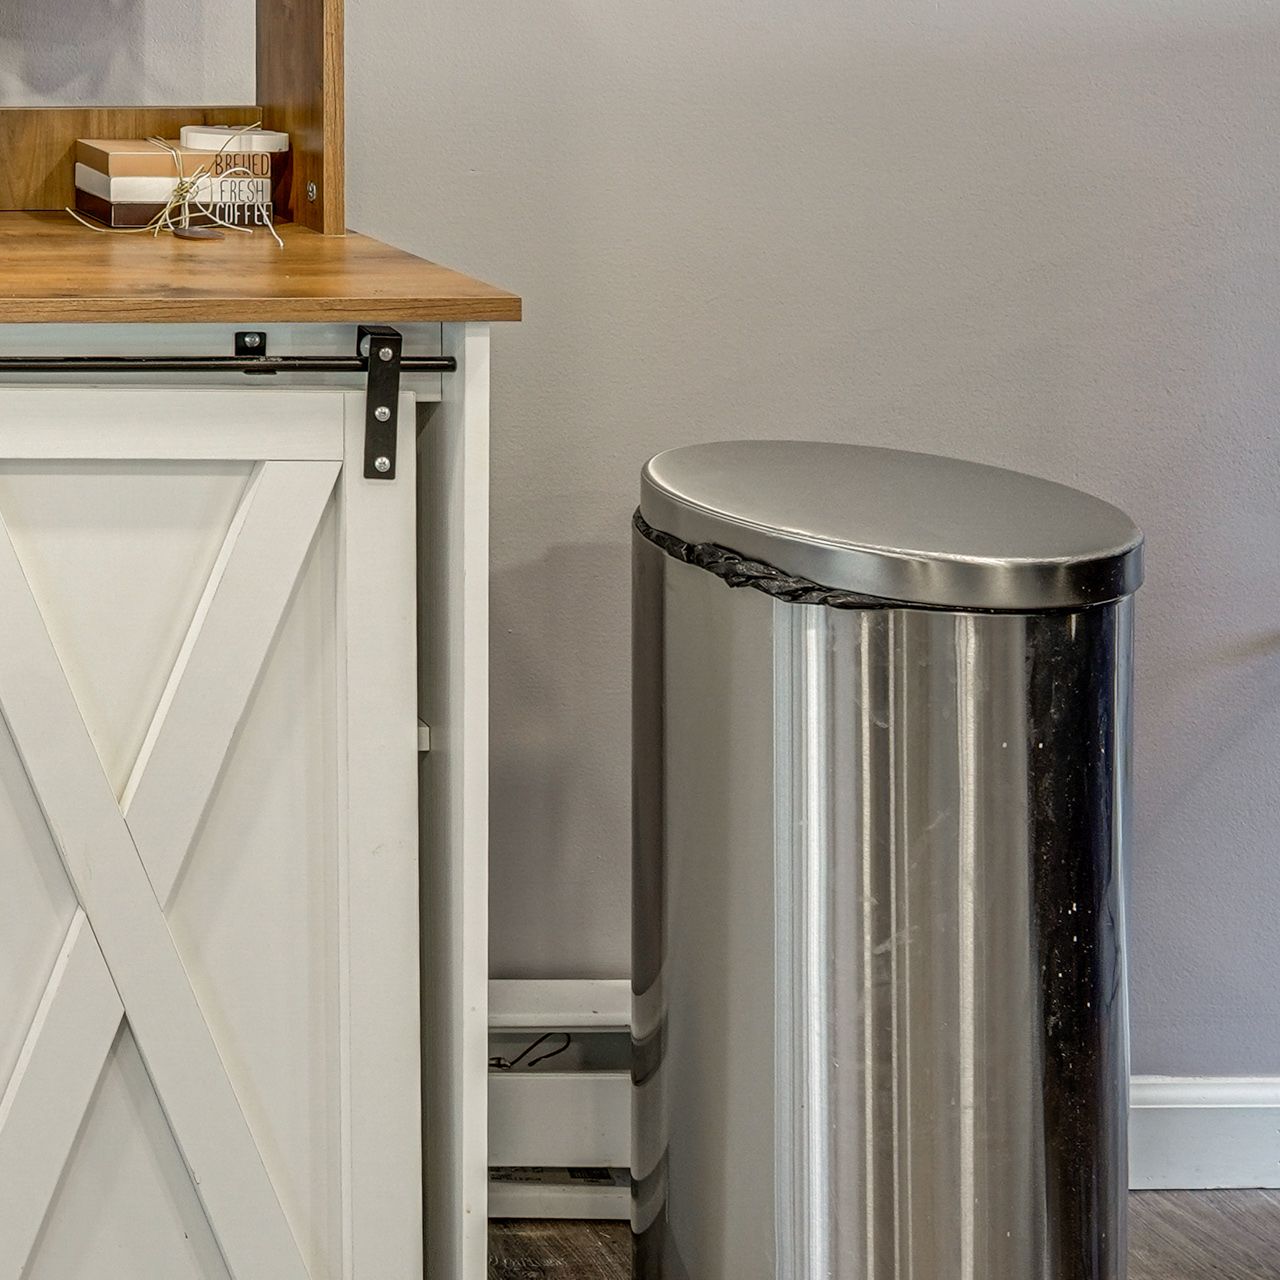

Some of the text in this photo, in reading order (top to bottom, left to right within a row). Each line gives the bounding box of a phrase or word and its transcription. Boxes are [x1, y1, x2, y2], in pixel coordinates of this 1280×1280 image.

[214, 153, 270, 176] BREWED
[220, 179, 264, 202] FRESH
[215, 202, 271, 226] COFFEE
